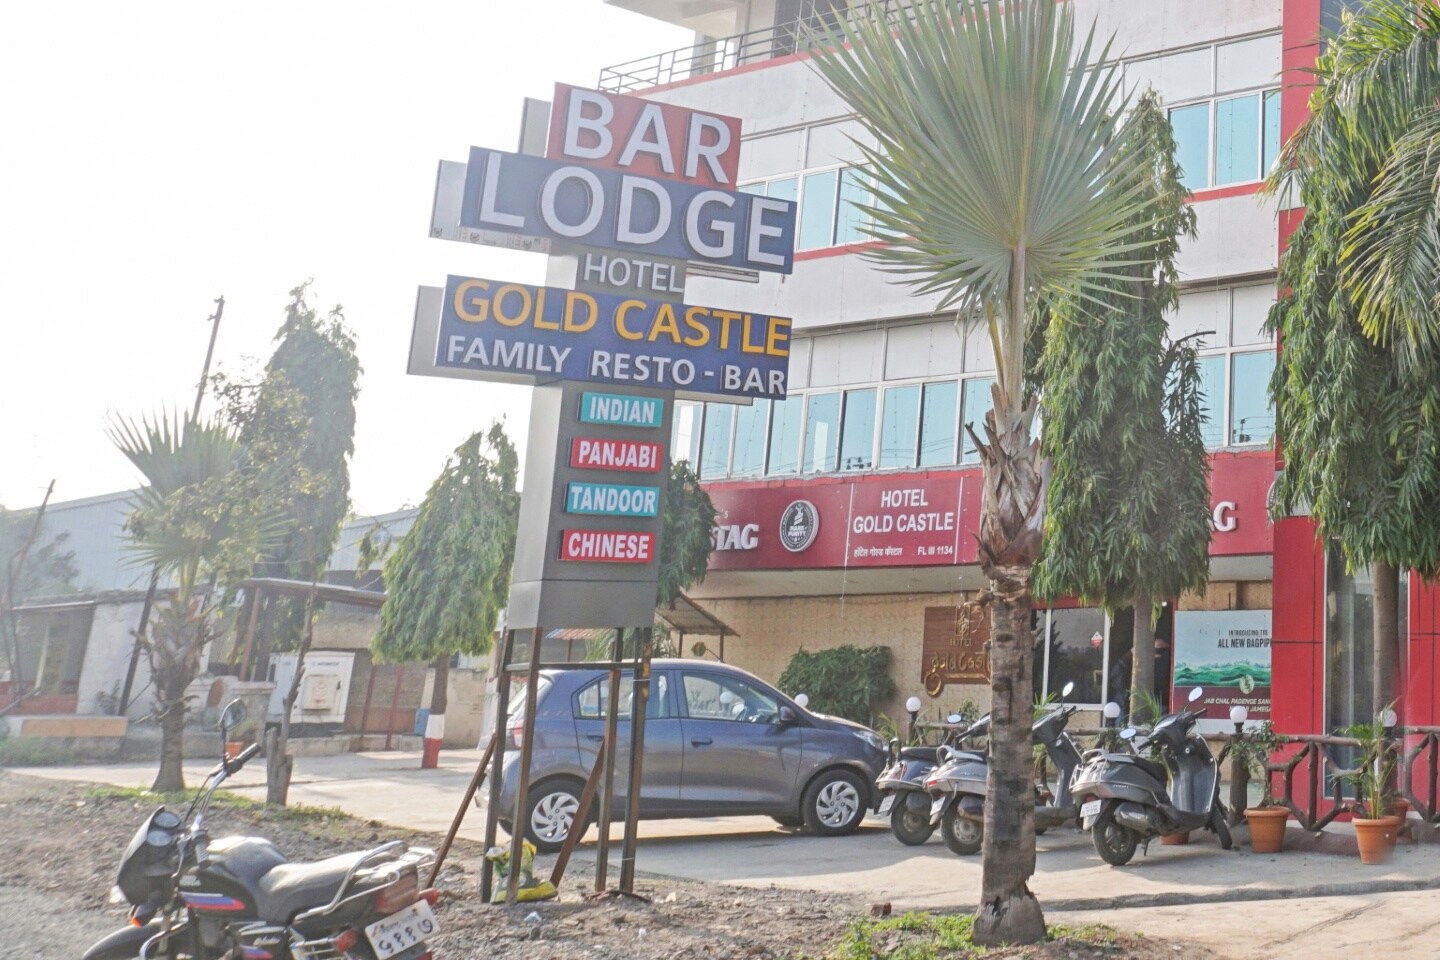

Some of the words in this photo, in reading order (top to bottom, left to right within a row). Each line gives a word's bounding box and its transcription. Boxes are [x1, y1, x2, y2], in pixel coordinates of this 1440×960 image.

[563, 87, 732, 185] BAR
[479, 151, 789, 267] LODGE
[583, 252, 685, 294] HOTEL
[453, 279, 598, 332] GOLD
[614, 299, 791, 357] CASTLE
[446, 335, 572, 373] FAMILY
[589, 396, 655, 424] INDIAN
[578, 440, 657, 469] PANJABI
[571, 486, 656, 513] TANDOOR
[881, 489, 928, 508] HOTEL
[853, 514, 893, 533] GOLD
[896, 512, 954, 532] CASTLE
[568, 532, 649, 559] CHINESE
[918, 546, 927, 556] FL
[937, 545, 953, 555] 1134
[1218, 638, 1229, 648] ALL
[1231, 638, 1245, 648] NEW
